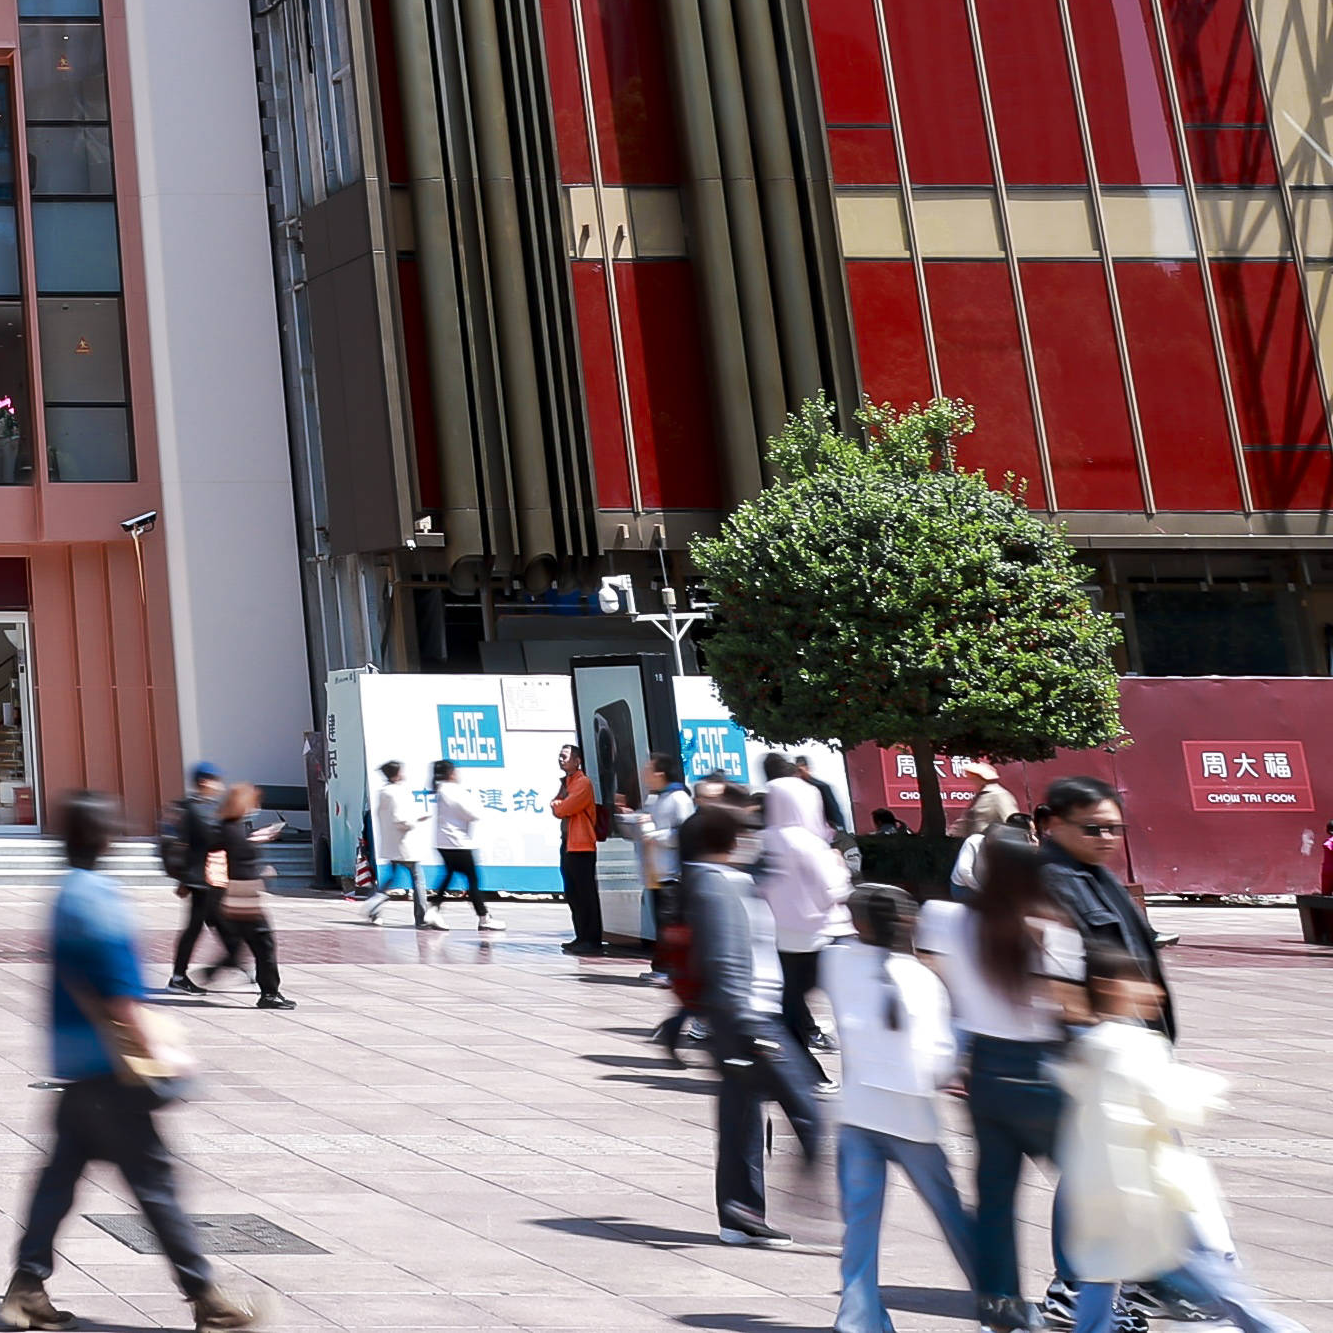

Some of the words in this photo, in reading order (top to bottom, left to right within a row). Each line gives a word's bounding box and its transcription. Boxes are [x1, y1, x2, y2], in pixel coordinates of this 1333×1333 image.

[1201, 752, 1292, 778] 周大福
[412, 787, 544, 813] 中建筑
[900, 791, 921, 800] CHO
[1207, 793, 1240, 803] CHOW
[1242, 793, 1261, 803] TAI
[1265, 793, 1297, 803] FOOK
